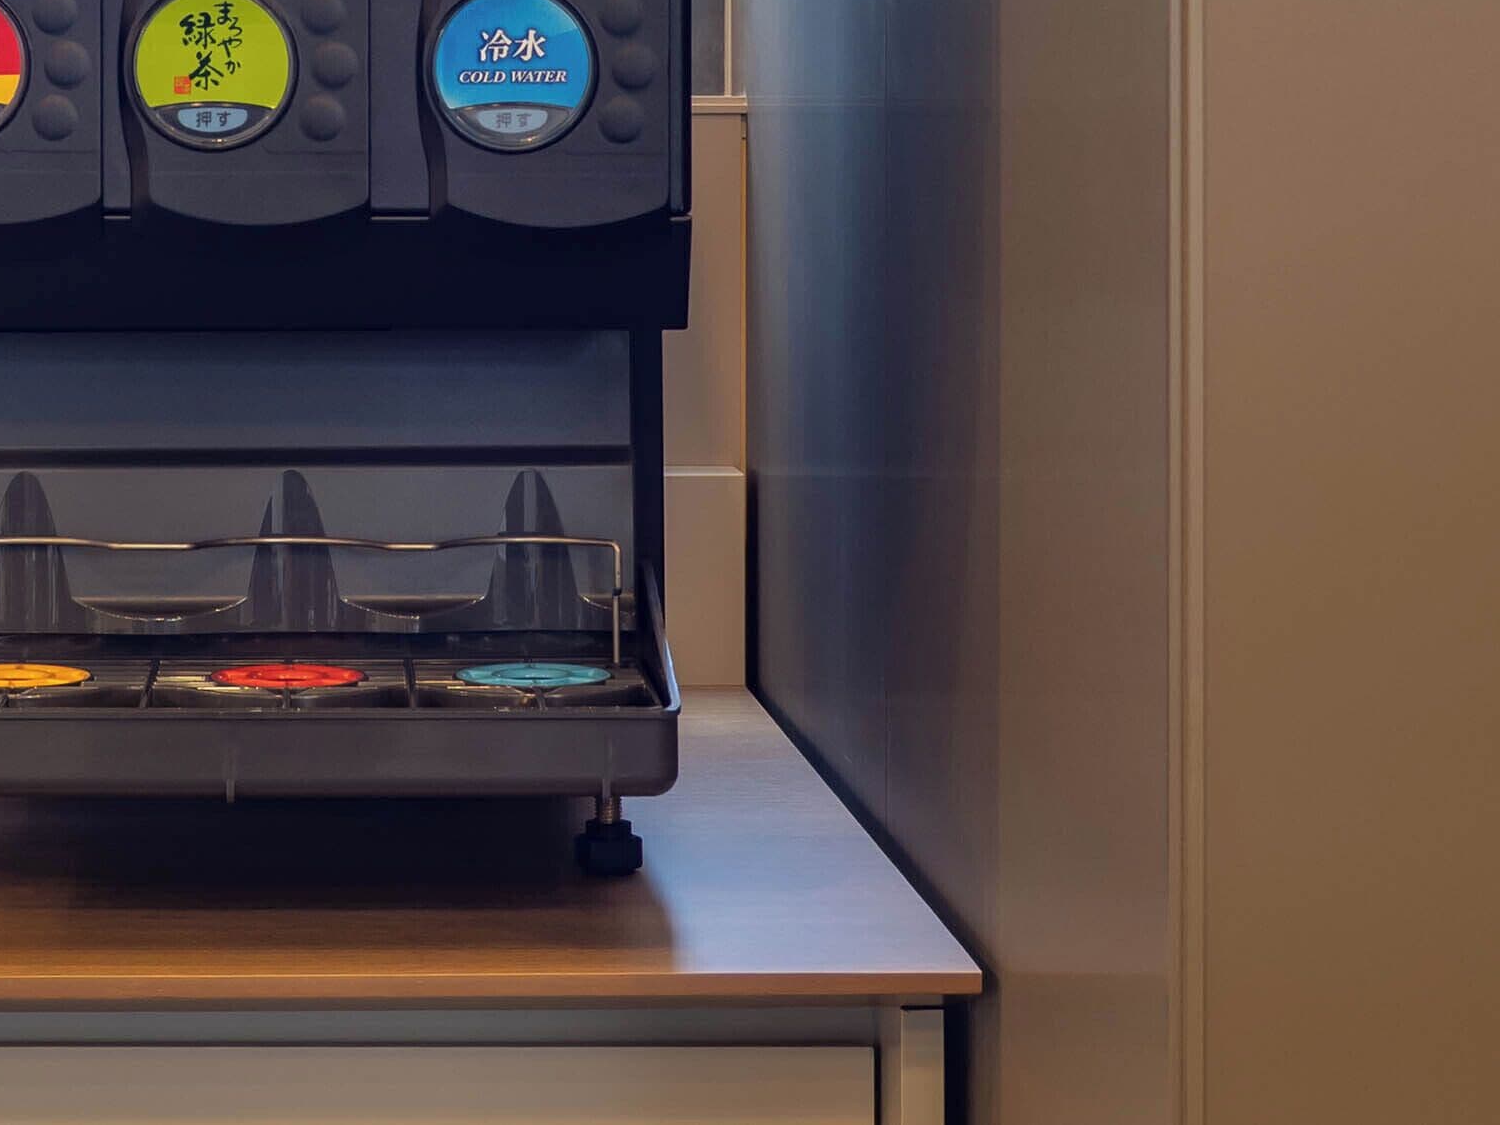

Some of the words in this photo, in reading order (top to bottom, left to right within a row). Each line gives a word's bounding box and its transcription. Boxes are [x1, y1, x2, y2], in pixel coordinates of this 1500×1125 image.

[214, 1, 243, 75] まろやか
[479, 29, 547, 62] 冷水
[179, 12, 225, 91] 緑茶
[459, 71, 506, 84] COLD
[511, 70, 568, 84] WATER
[196, 111, 231, 128] 押す
[495, 112, 532, 129] 押す
